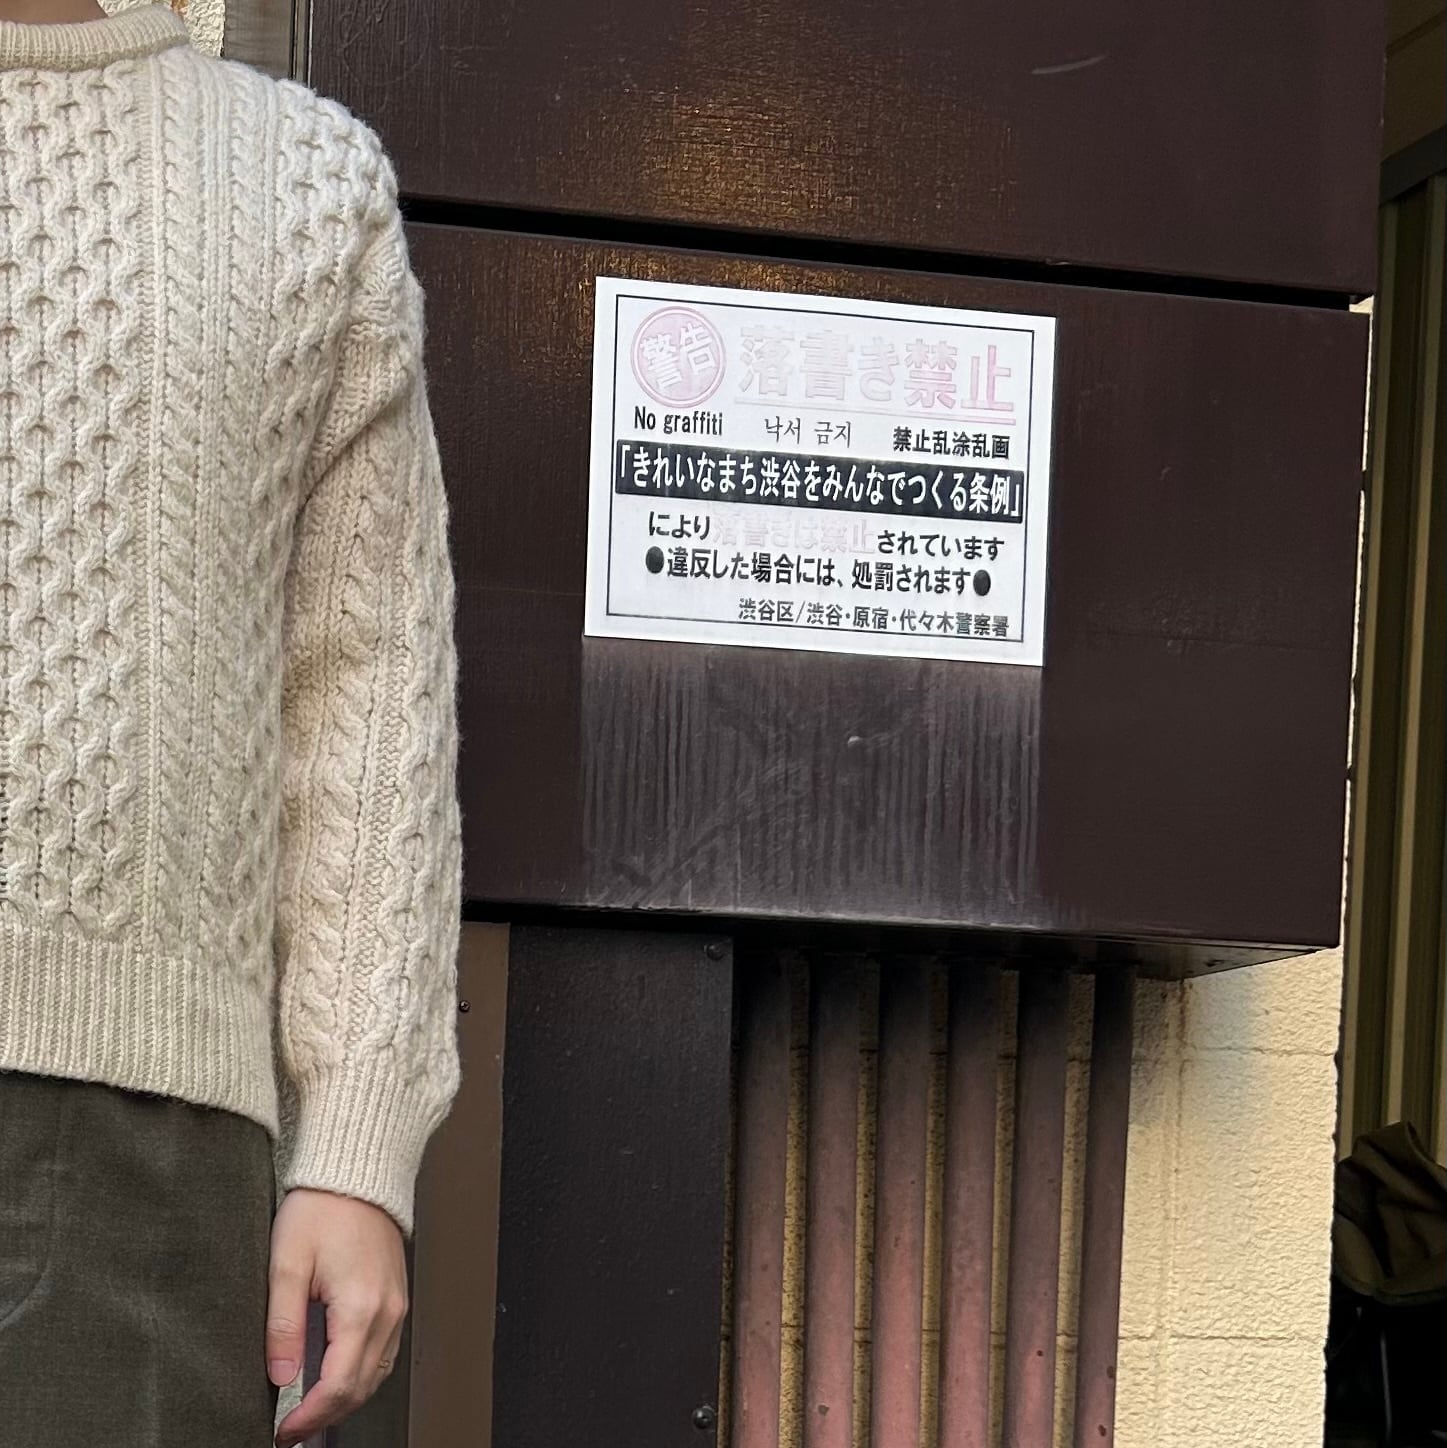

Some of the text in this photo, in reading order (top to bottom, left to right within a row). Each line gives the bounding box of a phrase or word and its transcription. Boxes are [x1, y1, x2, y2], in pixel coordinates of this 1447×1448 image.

[640, 321, 719, 391] 警告
[738, 324, 1015, 413] 落書き禁止
[633, 406, 723, 436] No graffiti
[763, 416, 852, 448] 낙서 금지
[892, 426, 1011, 460] 禁止乱涂乱画
[619, 445, 1022, 518] 「きれいなまち渋谷をみんなでつくる条例」
